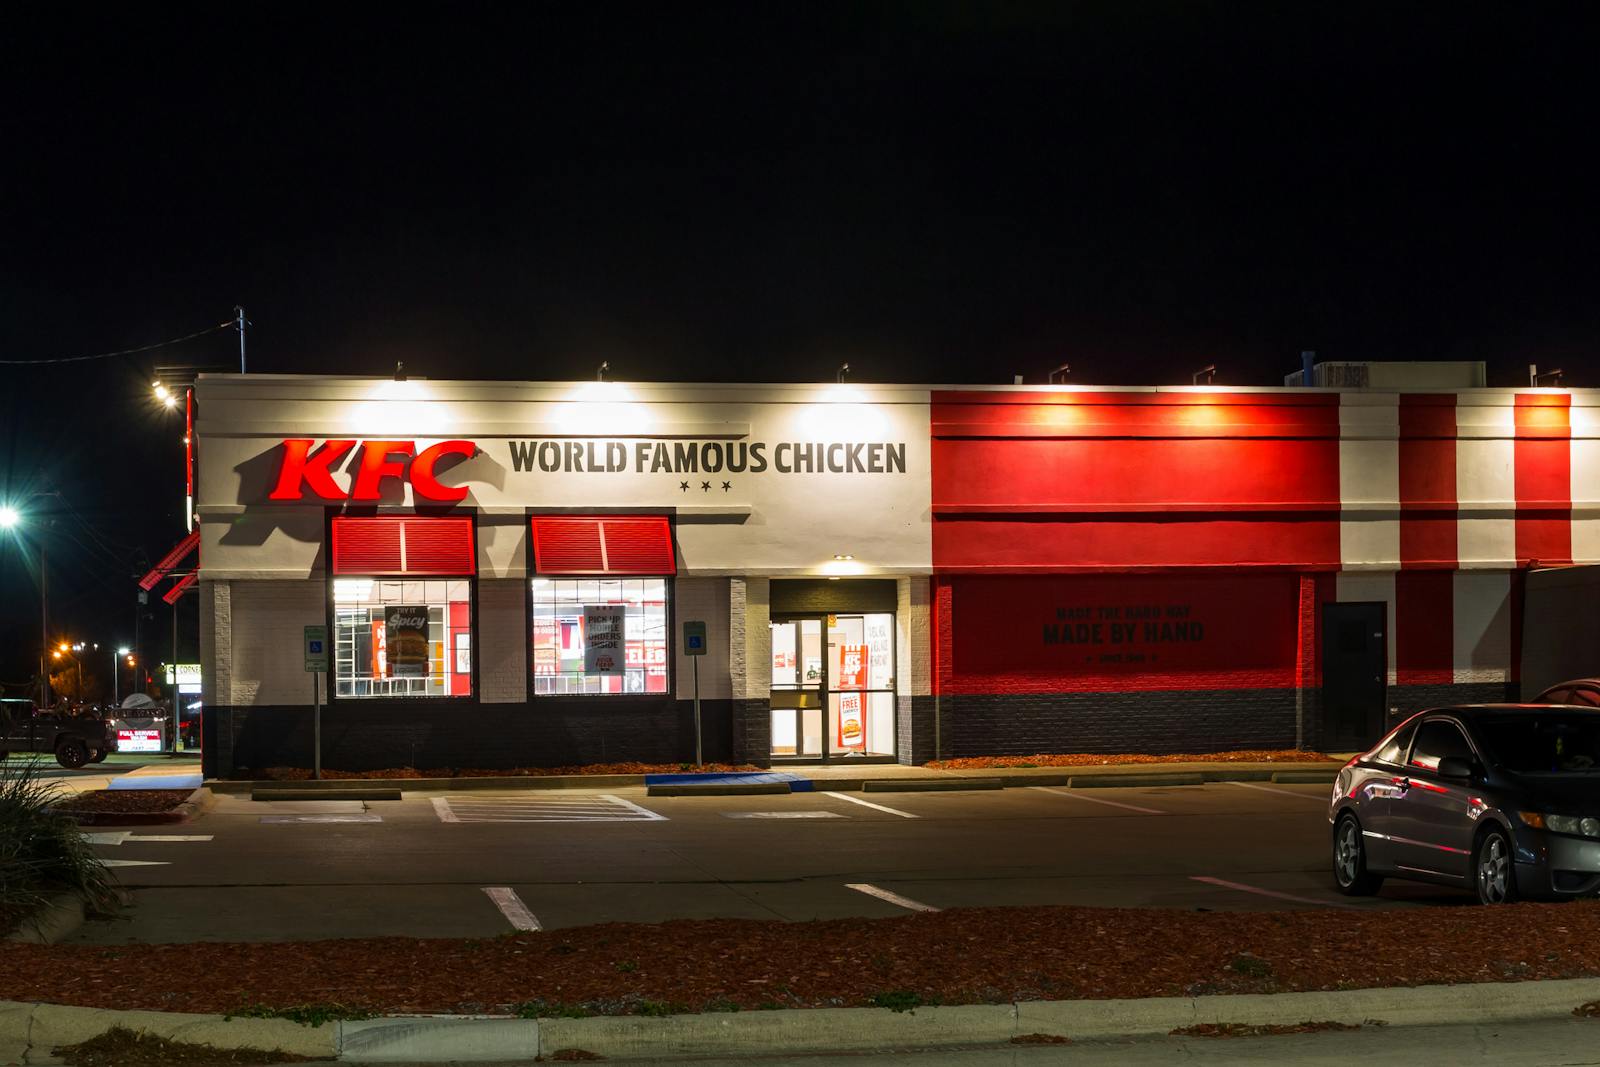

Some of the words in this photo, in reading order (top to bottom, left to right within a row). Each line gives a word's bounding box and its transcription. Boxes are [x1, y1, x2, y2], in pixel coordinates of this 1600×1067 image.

[509, 440, 627, 473] WORLD
[635, 441, 768, 473] FAMOUS
[775, 442, 907, 474] CHICKEN
[269, 438, 477, 502] KFC
[388, 613, 426, 631] Spicy
[588, 615, 607, 624] PICK
[609, 615, 621, 624] UP
[590, 624, 620, 632] MOBILE
[1042, 622, 1104, 644] MADE
[1110, 622, 1138, 643] BY
[1144, 621, 1205, 641] HAND
[589, 632, 622, 641] ORDERS
[591, 640, 619, 649] INSIDE
[844, 654, 861, 665] KFC
[843, 664, 861, 676] APP
[842, 700, 858, 710] FREE
